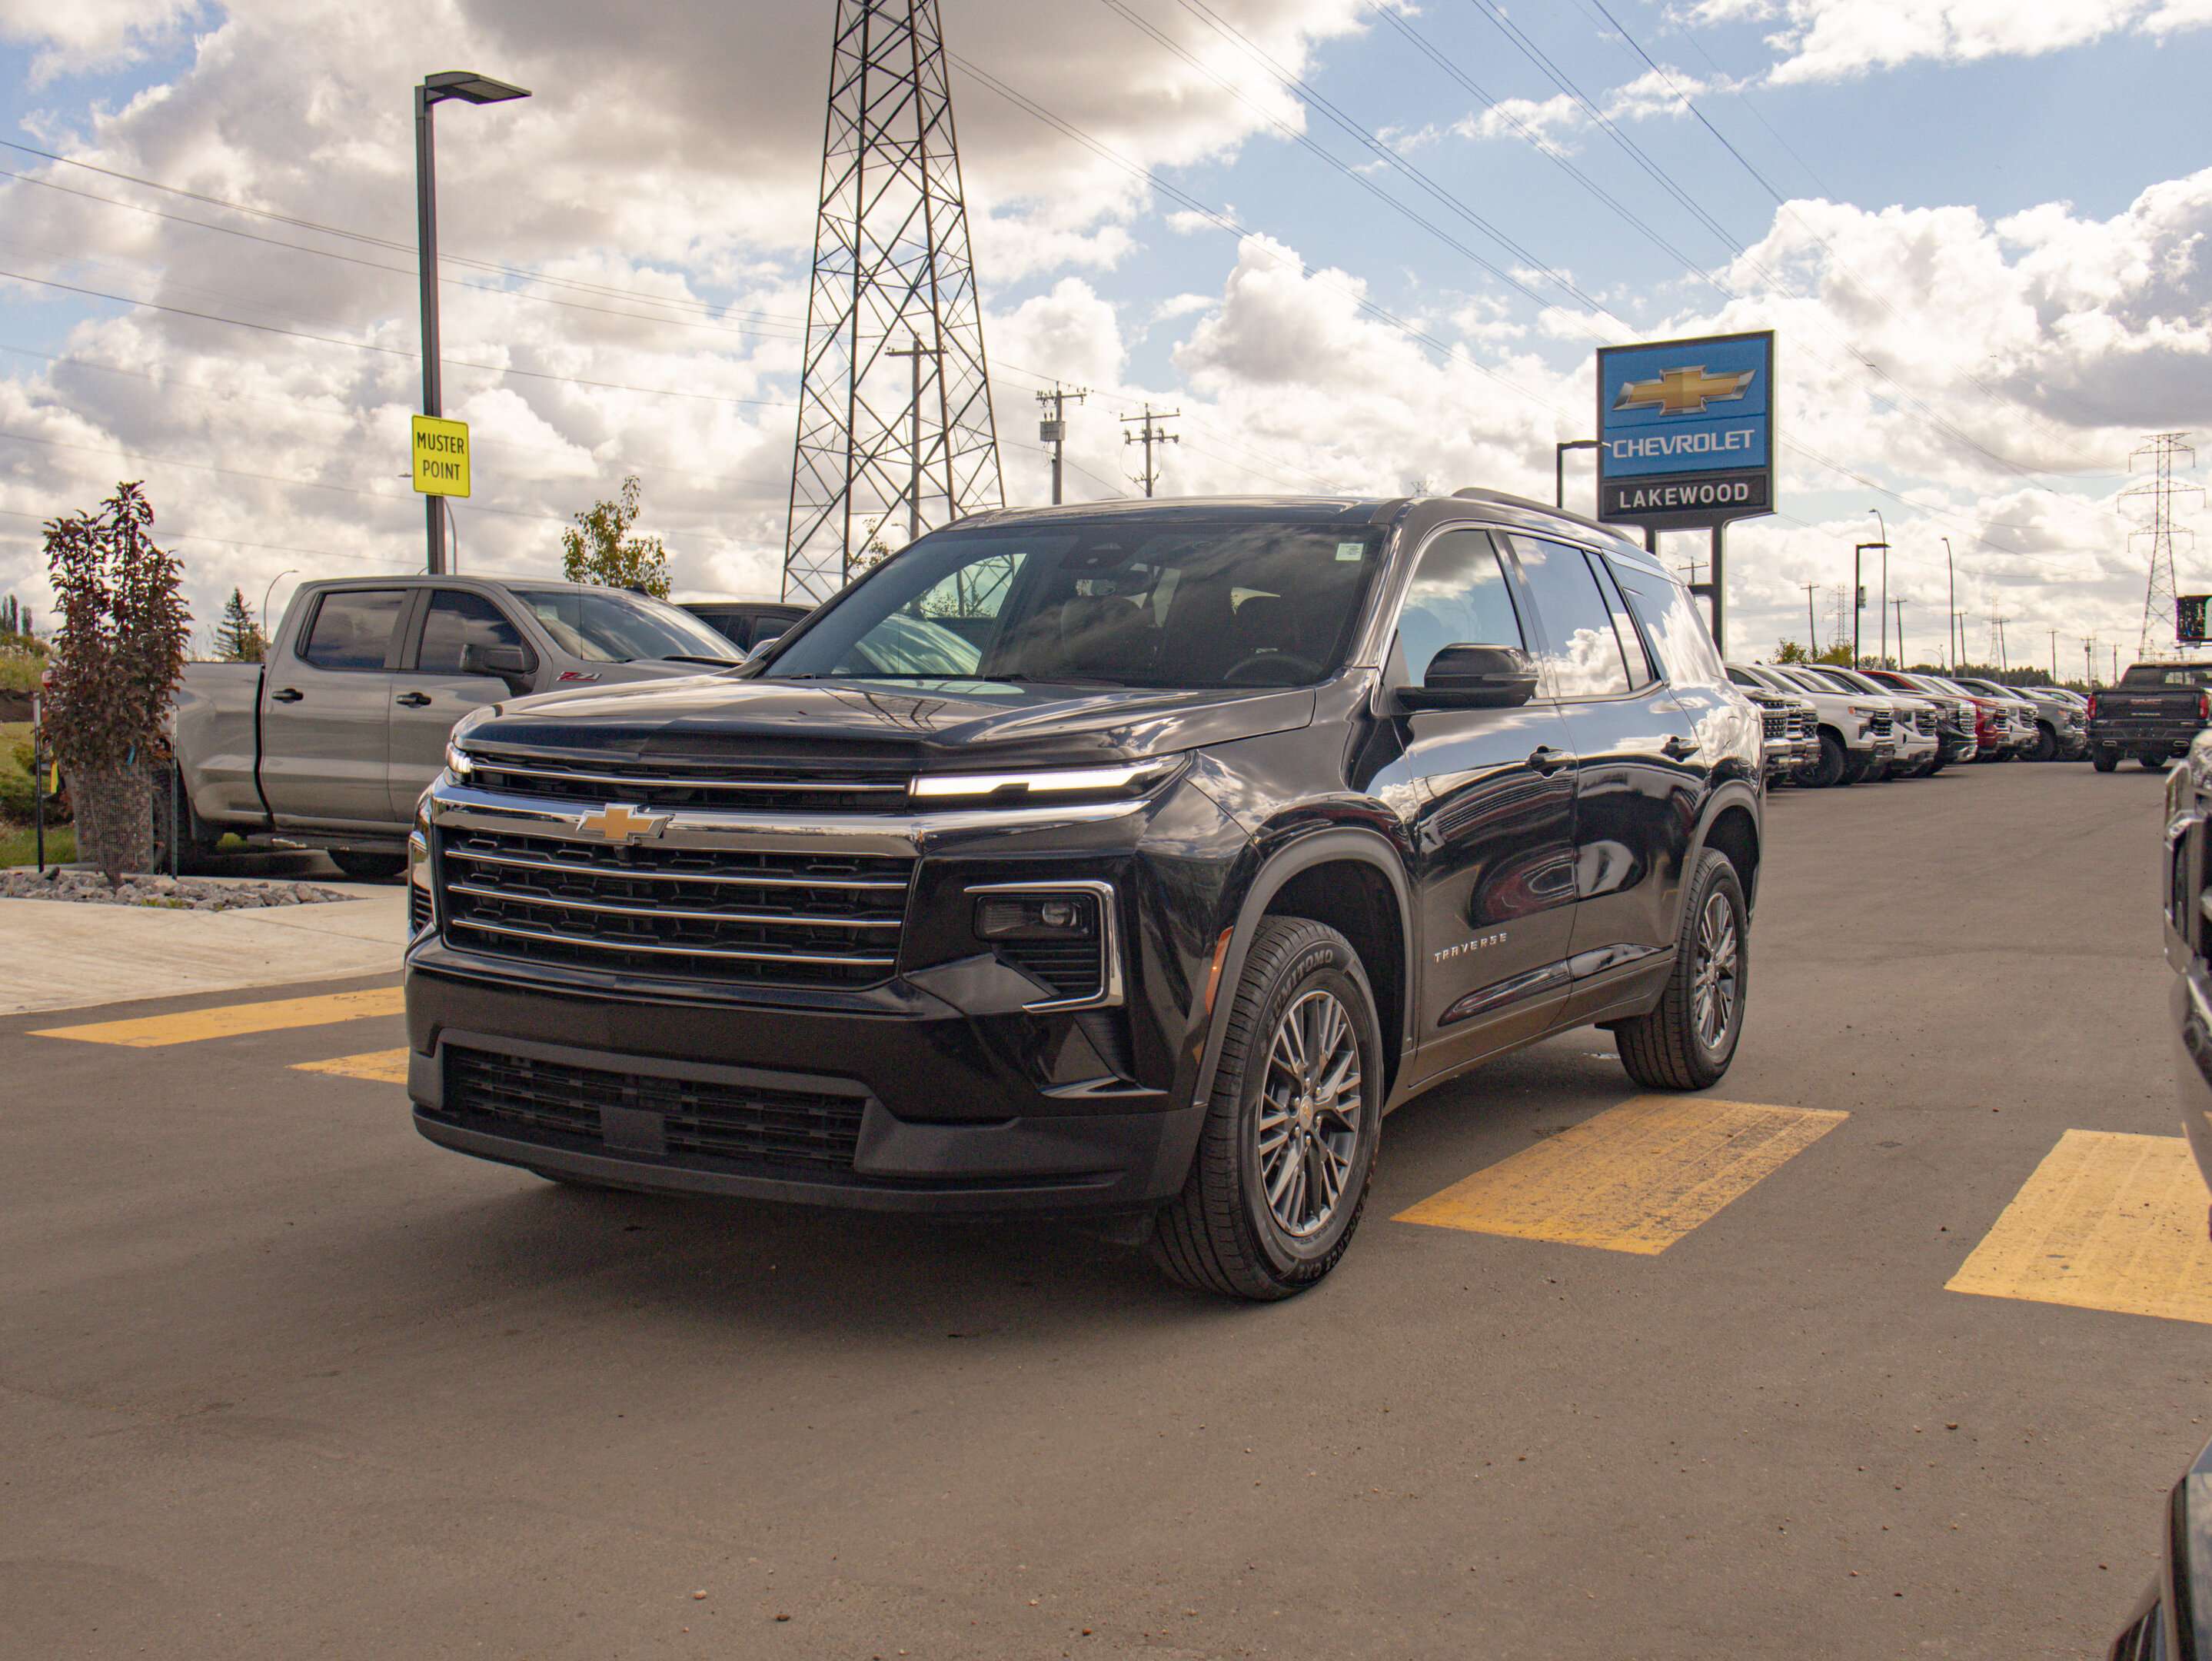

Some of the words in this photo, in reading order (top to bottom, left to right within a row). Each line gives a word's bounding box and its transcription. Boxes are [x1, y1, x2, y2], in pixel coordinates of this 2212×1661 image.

[417, 431, 464, 454] MUSTER
[1612, 429, 1755, 458] CHEVROLET
[423, 460, 461, 481] POINT
[1620, 483, 1749, 508] LAKEWOOD
[1434, 933, 1507, 963] TRAVERSE
